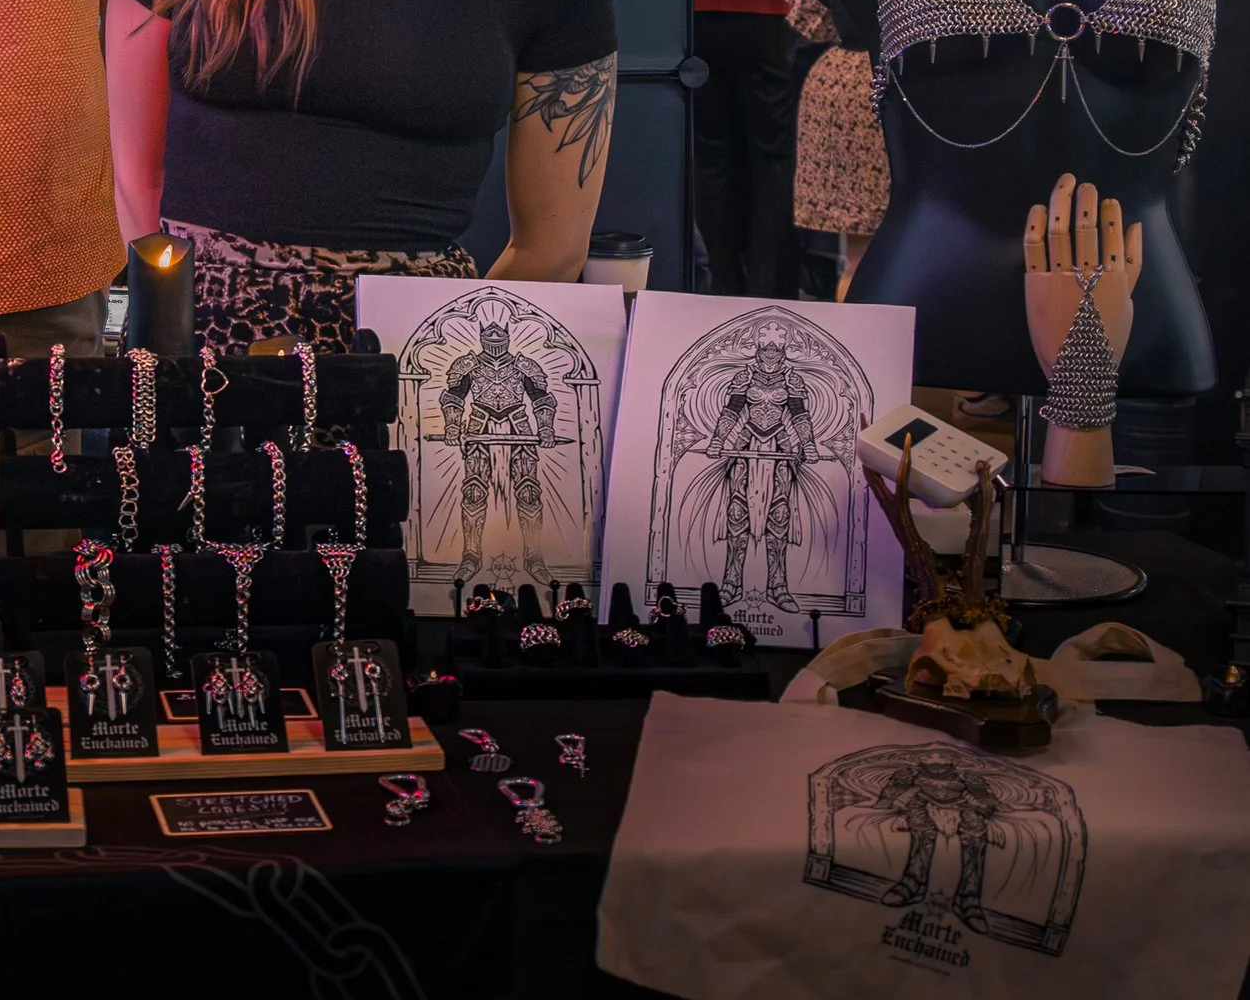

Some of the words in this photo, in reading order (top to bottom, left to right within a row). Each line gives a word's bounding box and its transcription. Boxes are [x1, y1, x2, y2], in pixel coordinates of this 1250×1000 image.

[733, 609, 774, 624] Morte
[92, 721, 139, 736] Morte
[81, 735, 149, 750] Enchained
[210, 732, 278, 747] Enchained
[900, 910, 963, 945] Morte
[881, 924, 971, 967] Enchained
